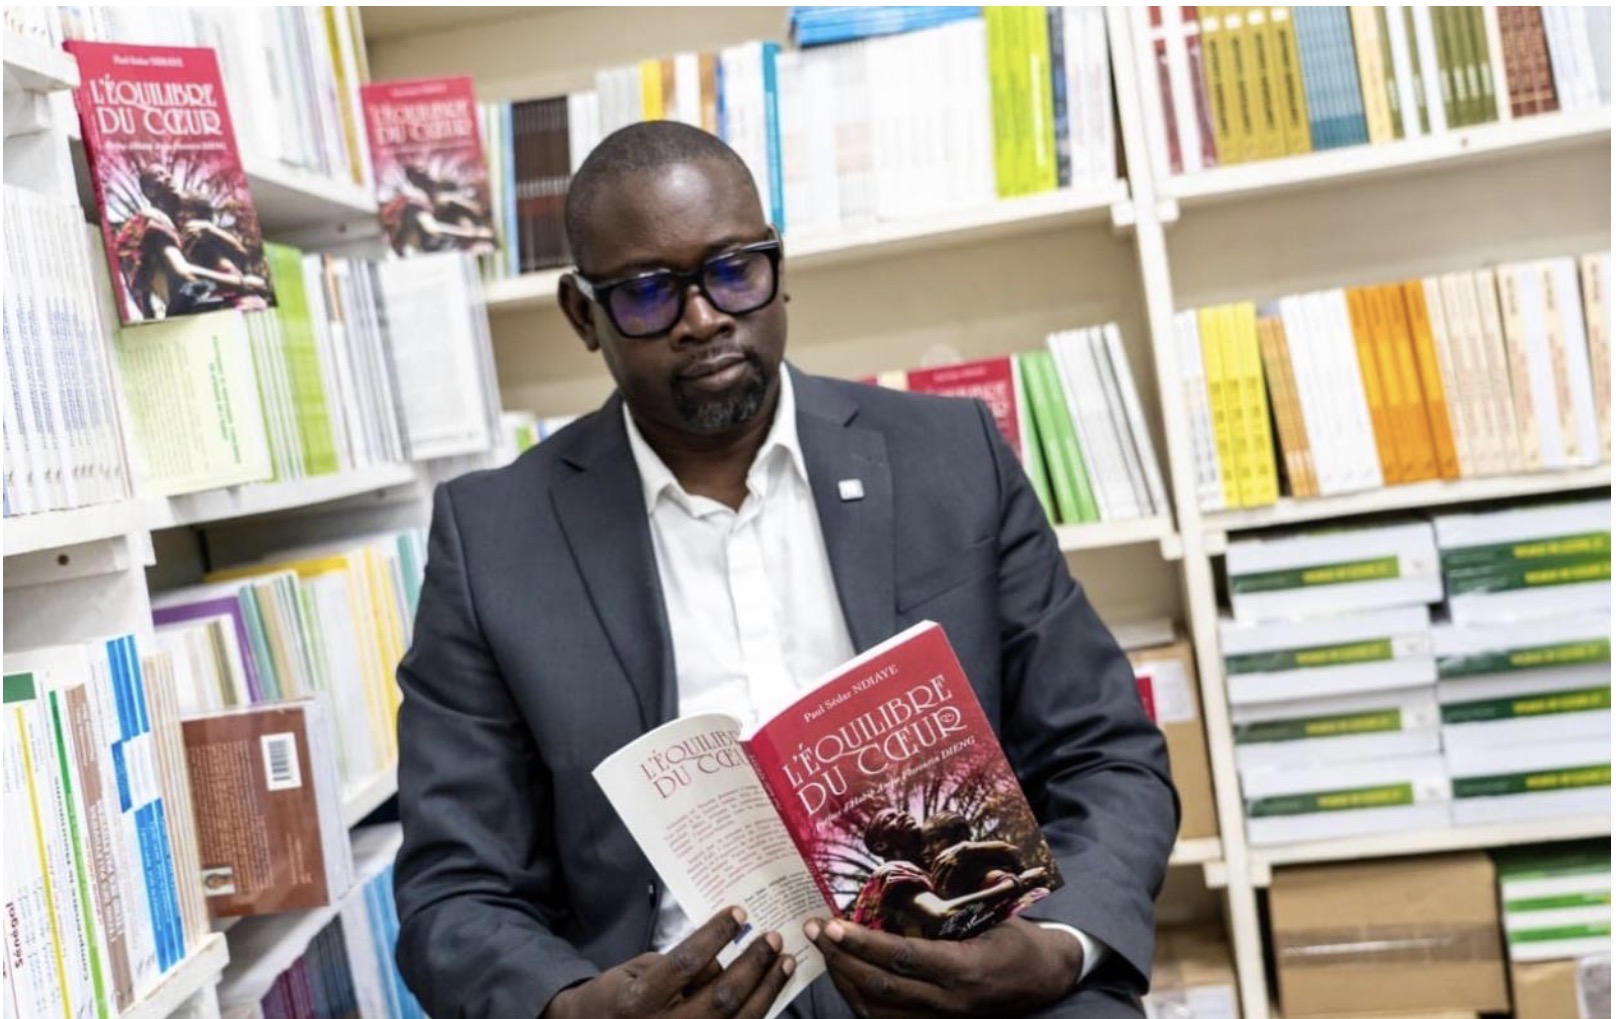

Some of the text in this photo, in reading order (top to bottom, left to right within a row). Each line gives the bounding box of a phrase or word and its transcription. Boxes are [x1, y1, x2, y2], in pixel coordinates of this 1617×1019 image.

[90, 73, 217, 109] L'ÉQUILIBRE
[97, 106, 223, 135] DU CŒUR
[803, 705, 825, 722] Paul
[851, 664, 898, 694] NDIAYE
[782, 674, 952, 788] L'ÉQUILIBRE
[941, 735, 976, 760] DIENG
[654, 765, 692, 799] DU
[797, 765, 847, 816] DU
[857, 706, 968, 774] CŒUR
[5, 901, 23, 969] Sénégal
